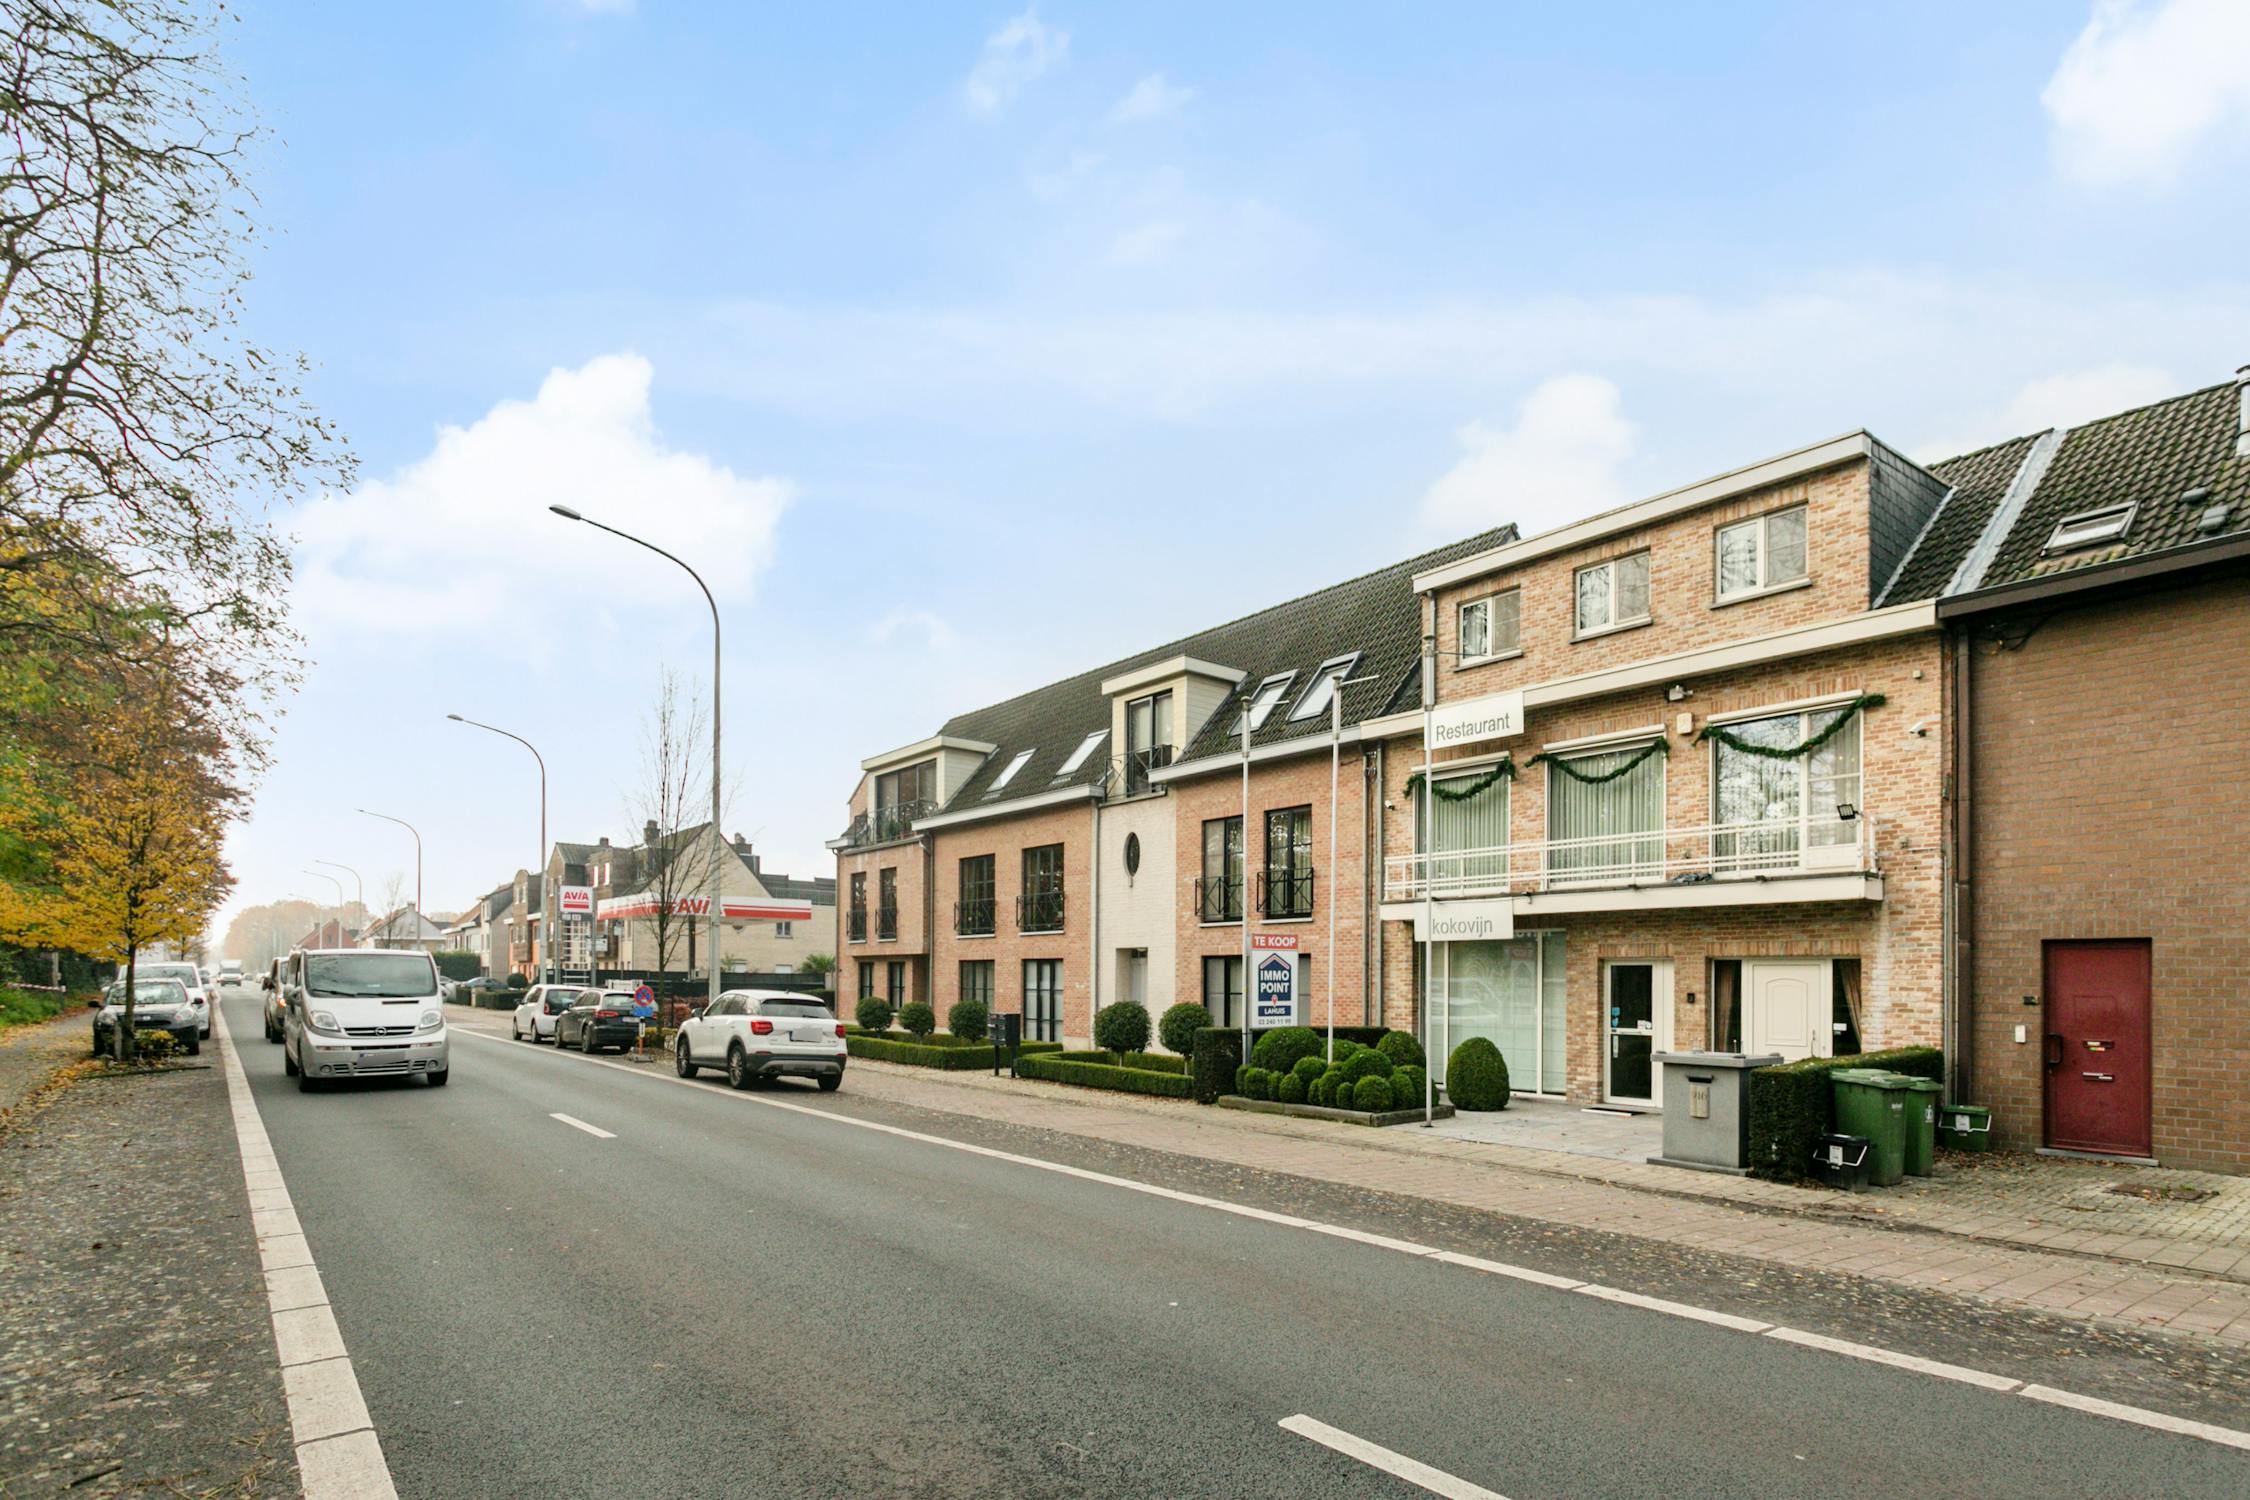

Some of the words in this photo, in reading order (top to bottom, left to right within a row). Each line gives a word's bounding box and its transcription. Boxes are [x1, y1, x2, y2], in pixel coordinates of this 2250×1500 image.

[1436, 713, 1510, 742] Restaurant
[677, 895, 714, 914] AVI
[1432, 916, 1493, 937] kokovijn
[1254, 936, 1266, 946] TE
[1268, 936, 1296, 947] KOOP
[1260, 970, 1289, 981] IMMO
[1260, 982, 1290, 993] POINT
